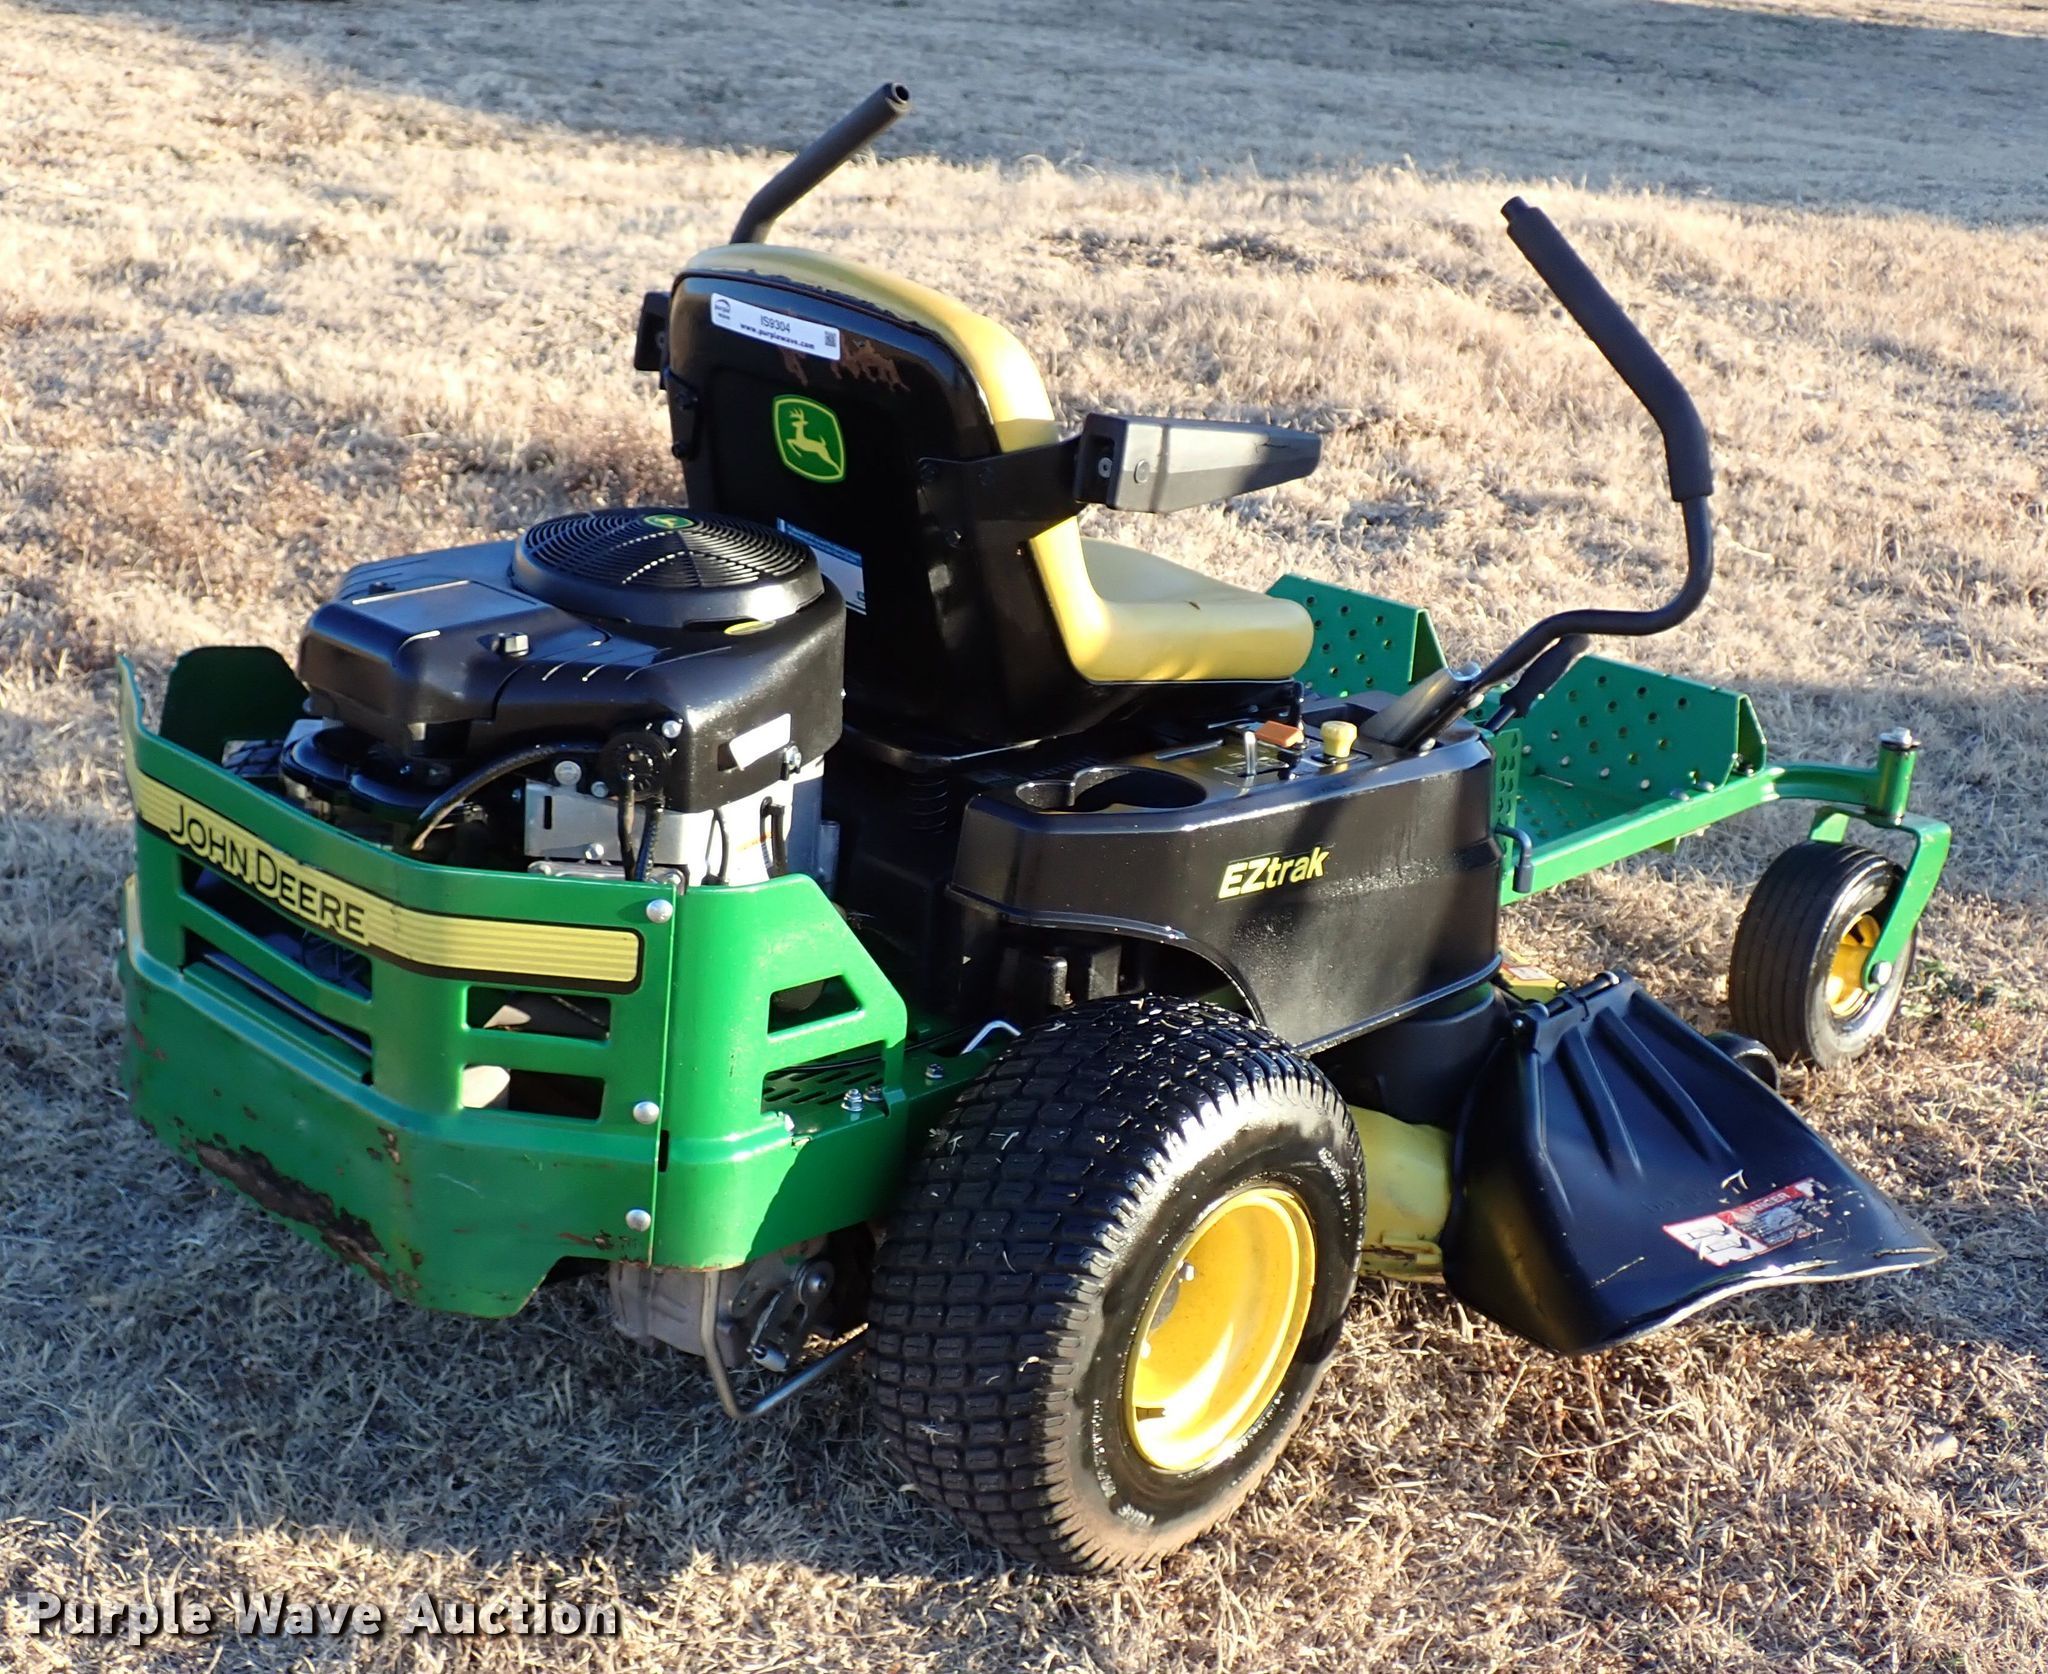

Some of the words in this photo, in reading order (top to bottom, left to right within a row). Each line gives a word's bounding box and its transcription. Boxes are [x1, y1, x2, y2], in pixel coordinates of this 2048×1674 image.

[740, 323, 815, 350] www.purplewave.com
[760, 314, 791, 333] IS9304
[170, 804, 247, 877] JOHN
[256, 848, 365, 938] DEERE
[1218, 846, 1330, 899] EZtrak
